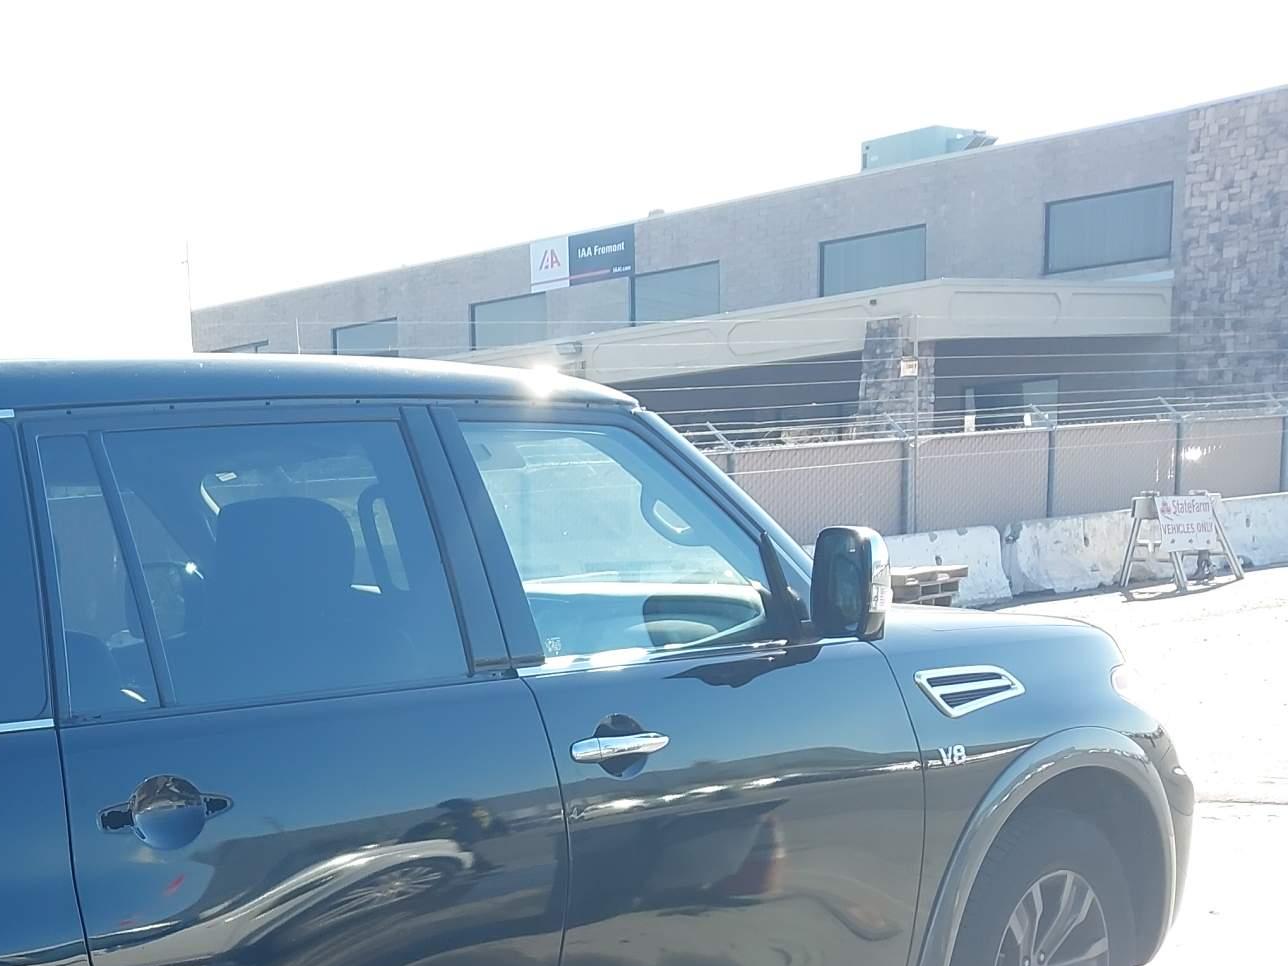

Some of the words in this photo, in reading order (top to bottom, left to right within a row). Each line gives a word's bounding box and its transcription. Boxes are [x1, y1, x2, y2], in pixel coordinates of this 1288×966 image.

[578, 246, 593, 259] IAA
[593, 241, 625, 256] Fremont
[1161, 523, 1195, 535] VEHICLES
[1196, 522, 1213, 533] ONLY
[938, 744, 966, 767] V8
